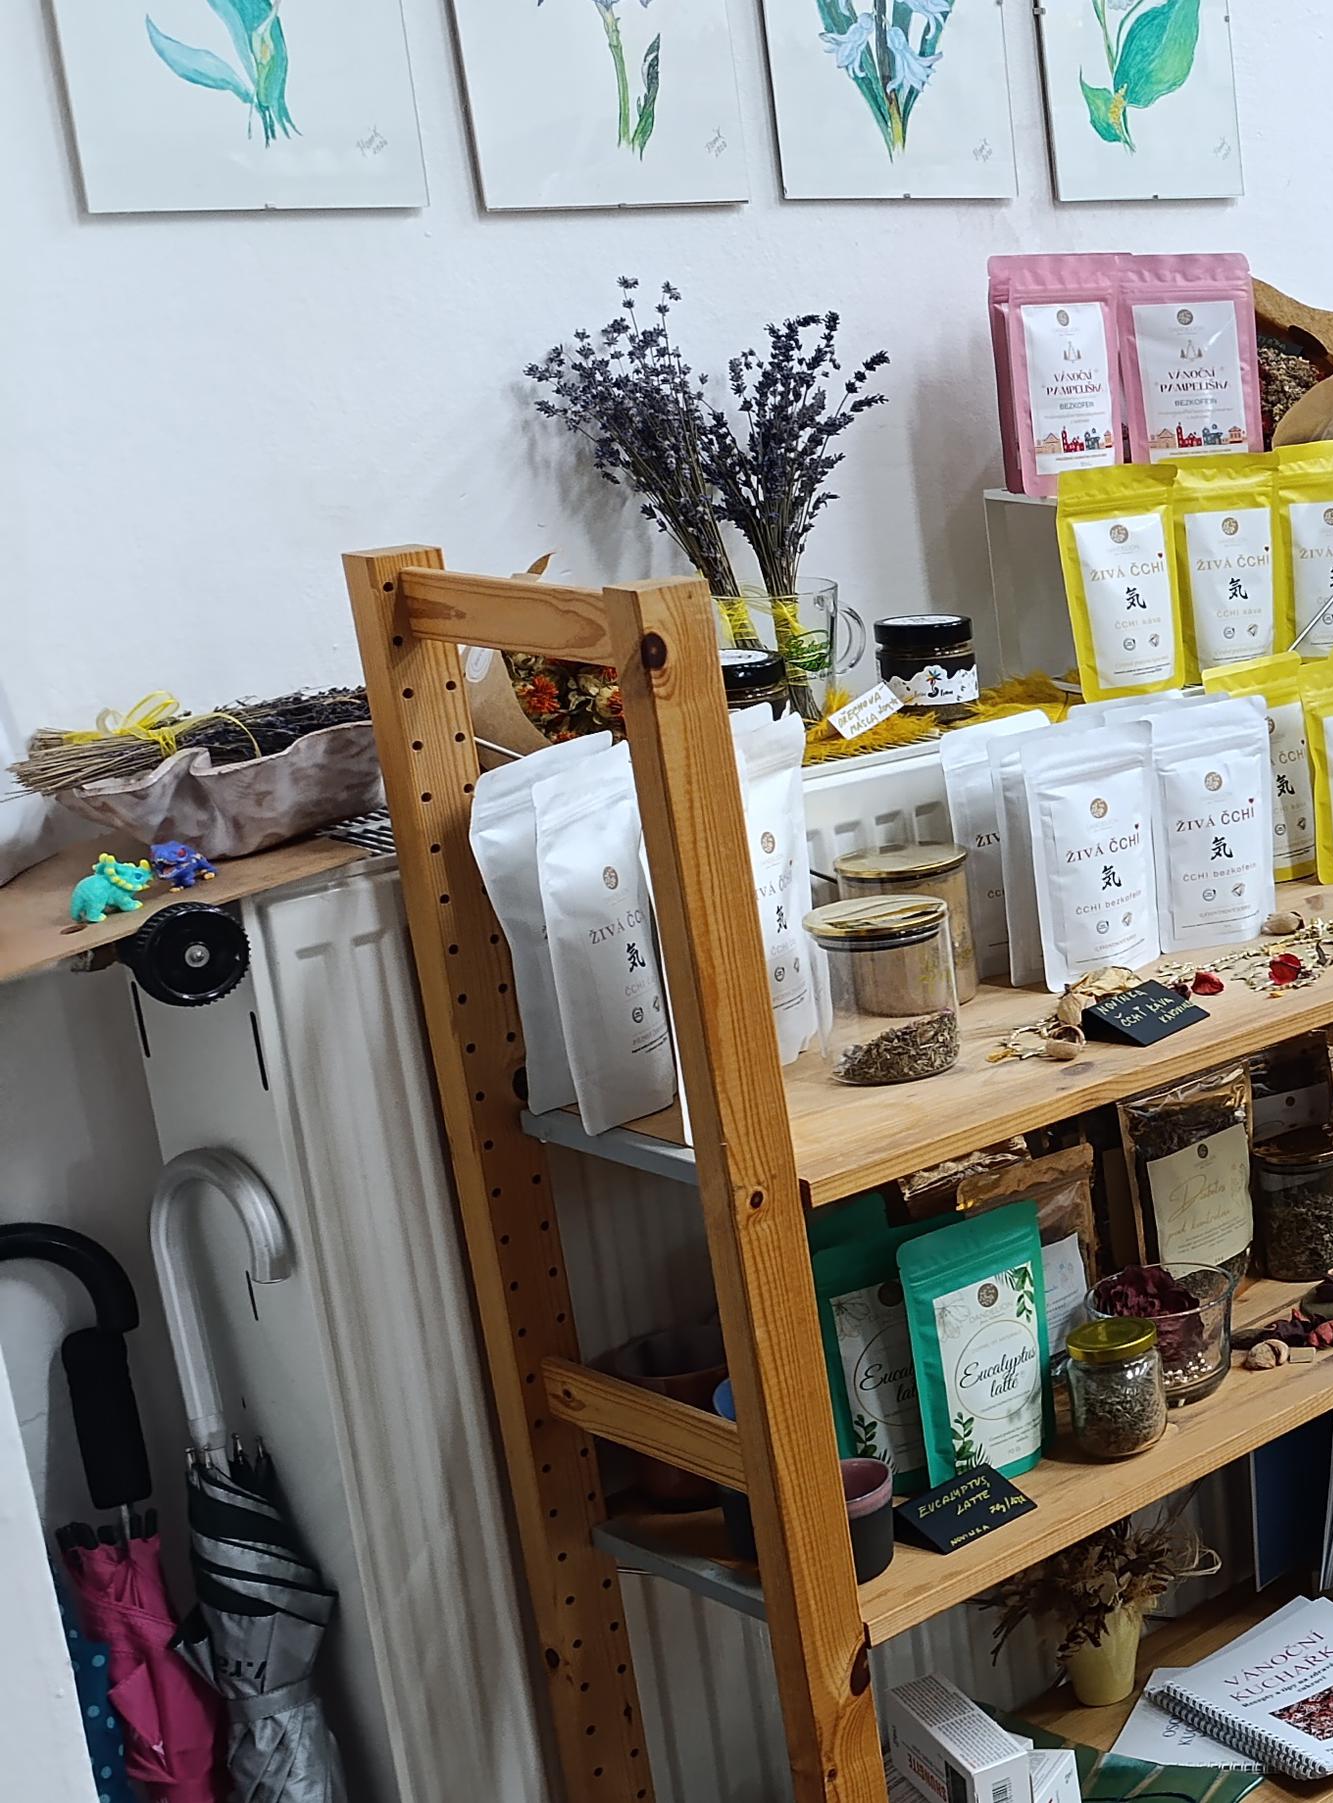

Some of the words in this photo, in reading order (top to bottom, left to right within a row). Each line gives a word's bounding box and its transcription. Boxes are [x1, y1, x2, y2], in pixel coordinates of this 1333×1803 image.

[1054, 369, 1093, 382] VÁNOČNÍ
[1168, 368, 1216, 380] VÁNOČNÍ
[1046, 381, 1103, 396] PAMPELIŠKA
[1160, 379, 1230, 393] PAMPELIŠKA
[1090, 565, 1125, 582] ŽIVÁ
[1196, 557, 1233, 572] ŽIVÁ
[1126, 587, 1147, 610] 気
[1228, 577, 1248, 600] 気
[1276, 774, 1296, 797] 気
[1176, 817, 1215, 833] ŽIVÁ
[1066, 846, 1104, 864] ŽIVÁ
[1210, 836, 1233, 860] 気
[1101, 865, 1122, 891] 気
[1182, 871, 1210, 883] ČCHI
[1213, 862, 1257, 877] bezkofein
[1076, 903, 1102, 915] ČCHI
[589, 917, 625, 945] ŽIVÁ
[626, 942, 646, 973] 気
[959, 1346, 1036, 1389] Eucalyptus
[956, 1489, 991, 1515] LATTE
[1223, 1629, 1325, 1686] VÁNOČNÍ
